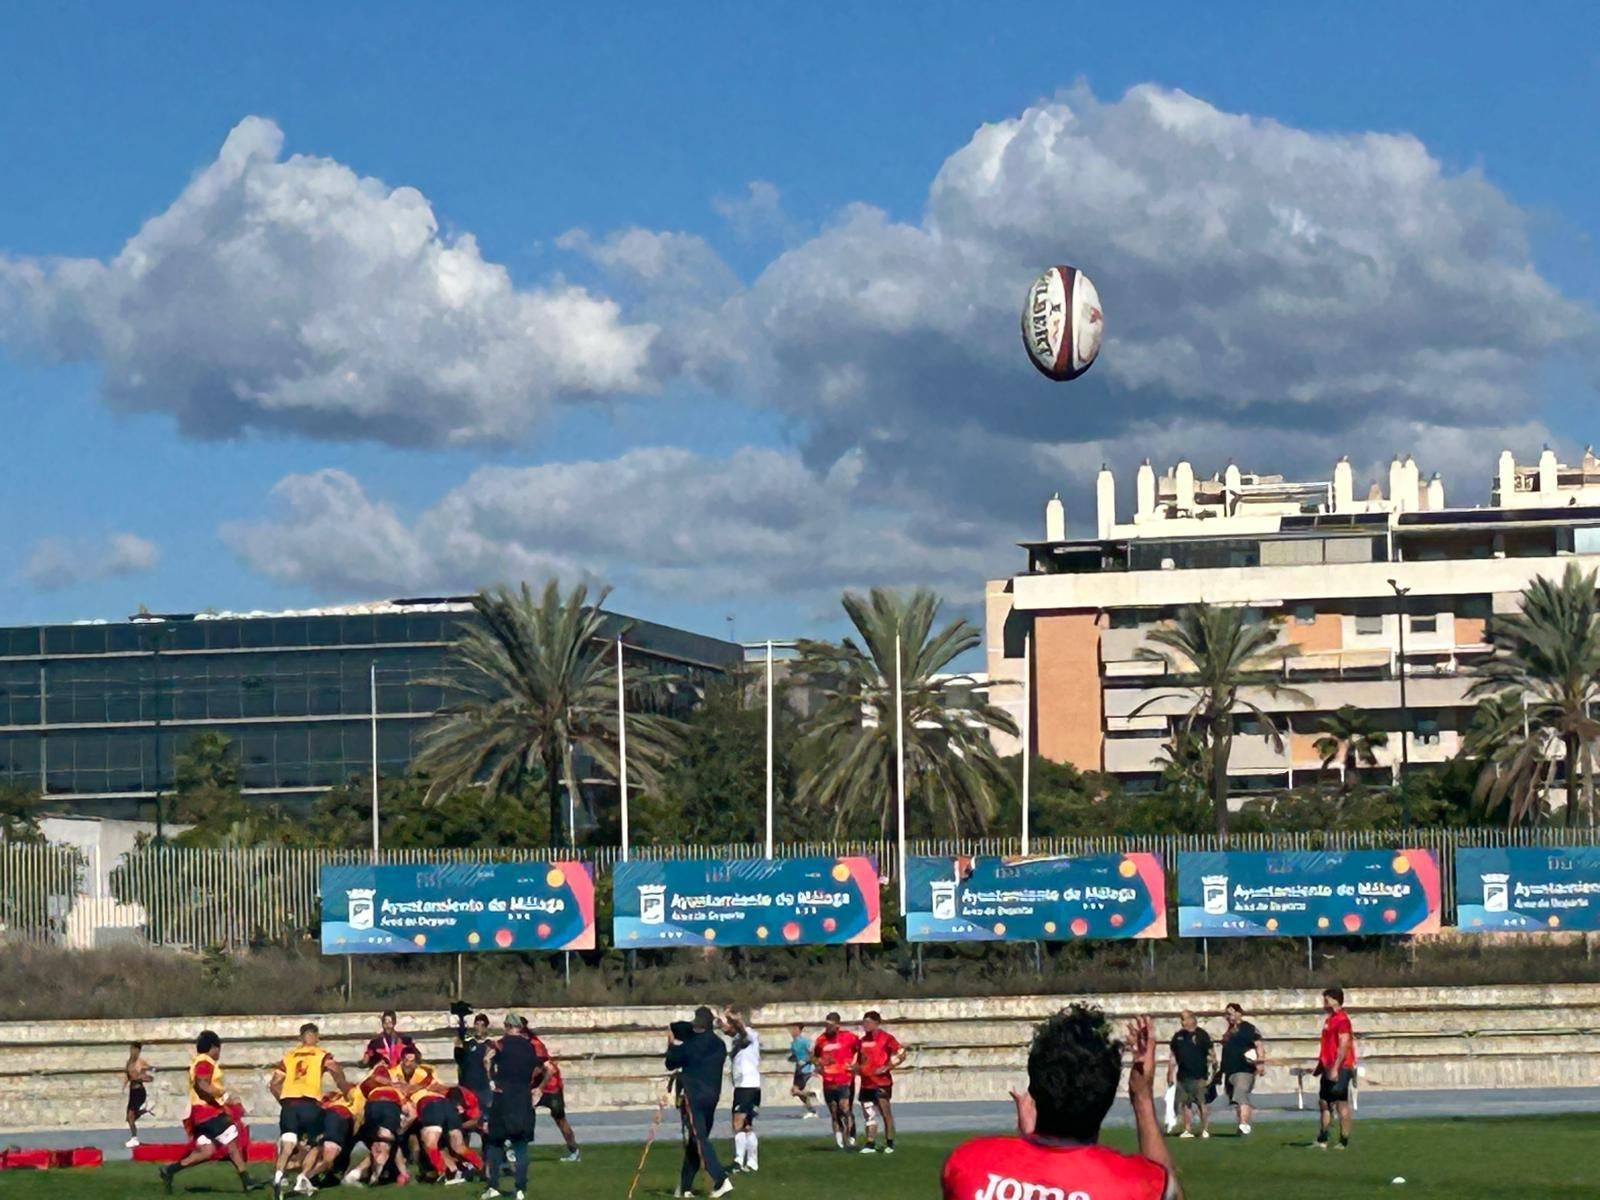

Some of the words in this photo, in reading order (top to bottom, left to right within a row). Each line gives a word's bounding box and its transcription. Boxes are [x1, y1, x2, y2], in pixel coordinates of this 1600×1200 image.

[671, 893, 772, 909] Ayuntamiento
[775, 893, 795, 906] de
[961, 888, 1060, 905] Ayuntamiento
[1063, 888, 1081, 901] de
[1233, 884, 1332, 901] Ayuntamiento
[1336, 884, 1355, 897] de
[380, 898, 485, 915] Ayuntamiento
[488, 899, 507, 912] de
